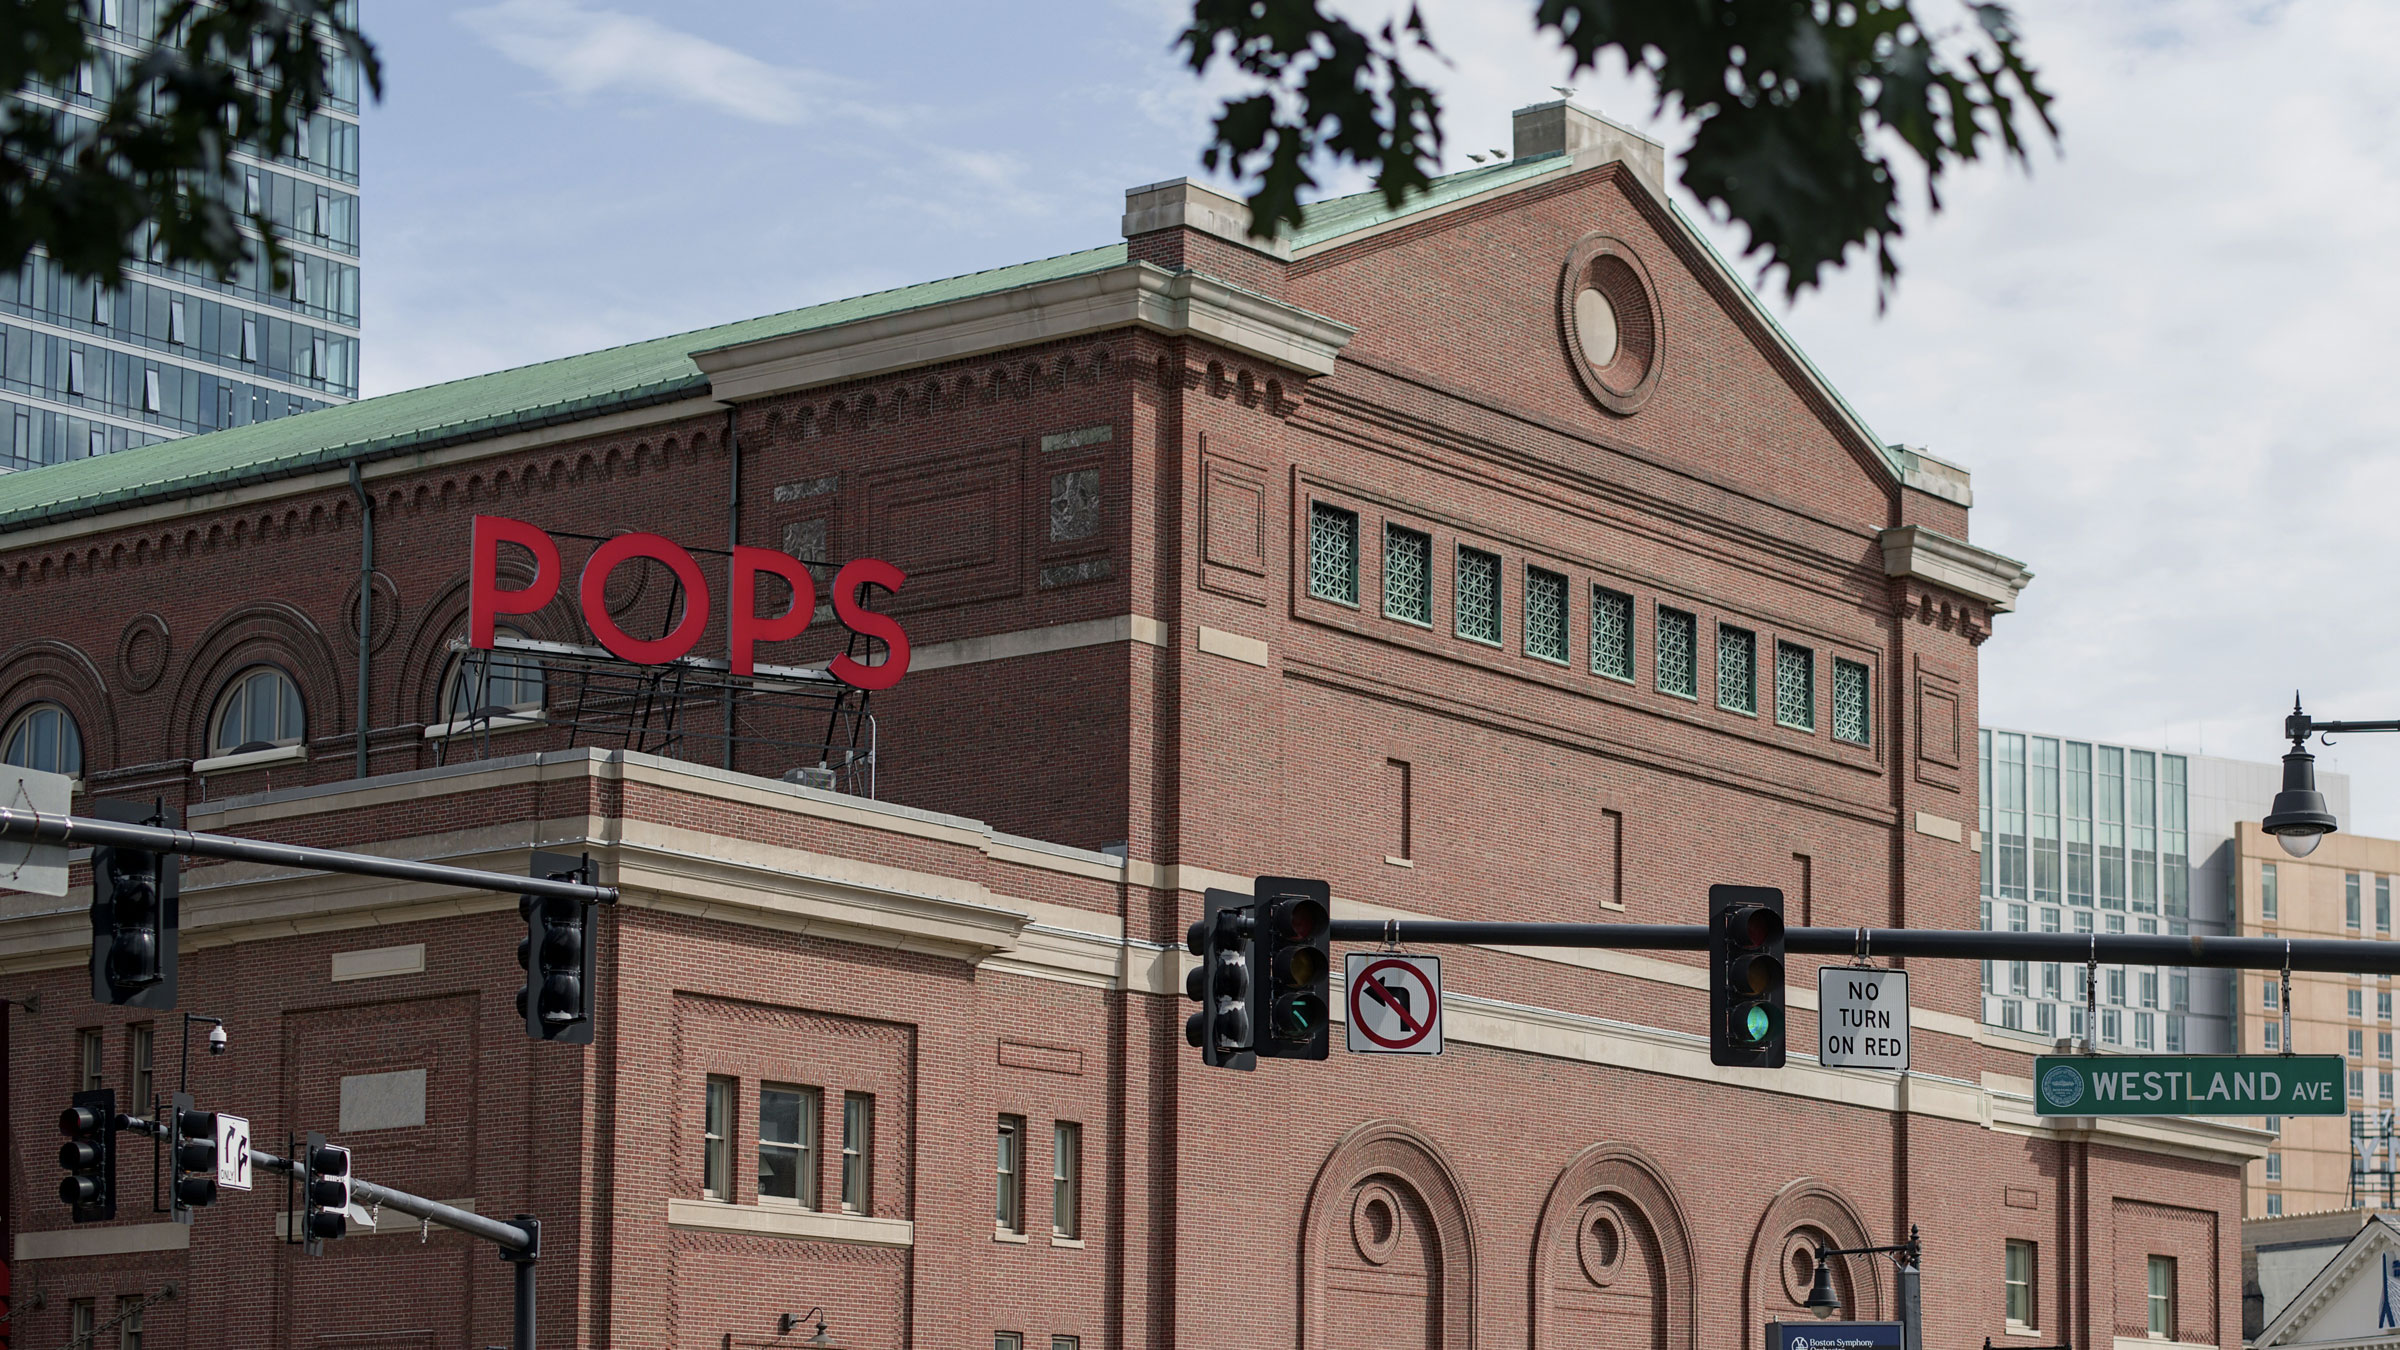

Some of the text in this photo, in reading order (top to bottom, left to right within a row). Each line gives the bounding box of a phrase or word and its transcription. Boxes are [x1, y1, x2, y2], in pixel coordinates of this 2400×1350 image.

[468, 514, 911, 690] POPS
[1848, 981, 1879, 1001] NO
[1839, 1008, 1890, 1029] TURN
[1828, 1035, 1902, 1057] ON RED
[2092, 1071, 2282, 1101] WESTLAND
[2291, 1082, 2333, 1101] AVE
[220, 1168, 235, 1181] ONLY
[1810, 1338, 1874, 1348] Boston Symphony
